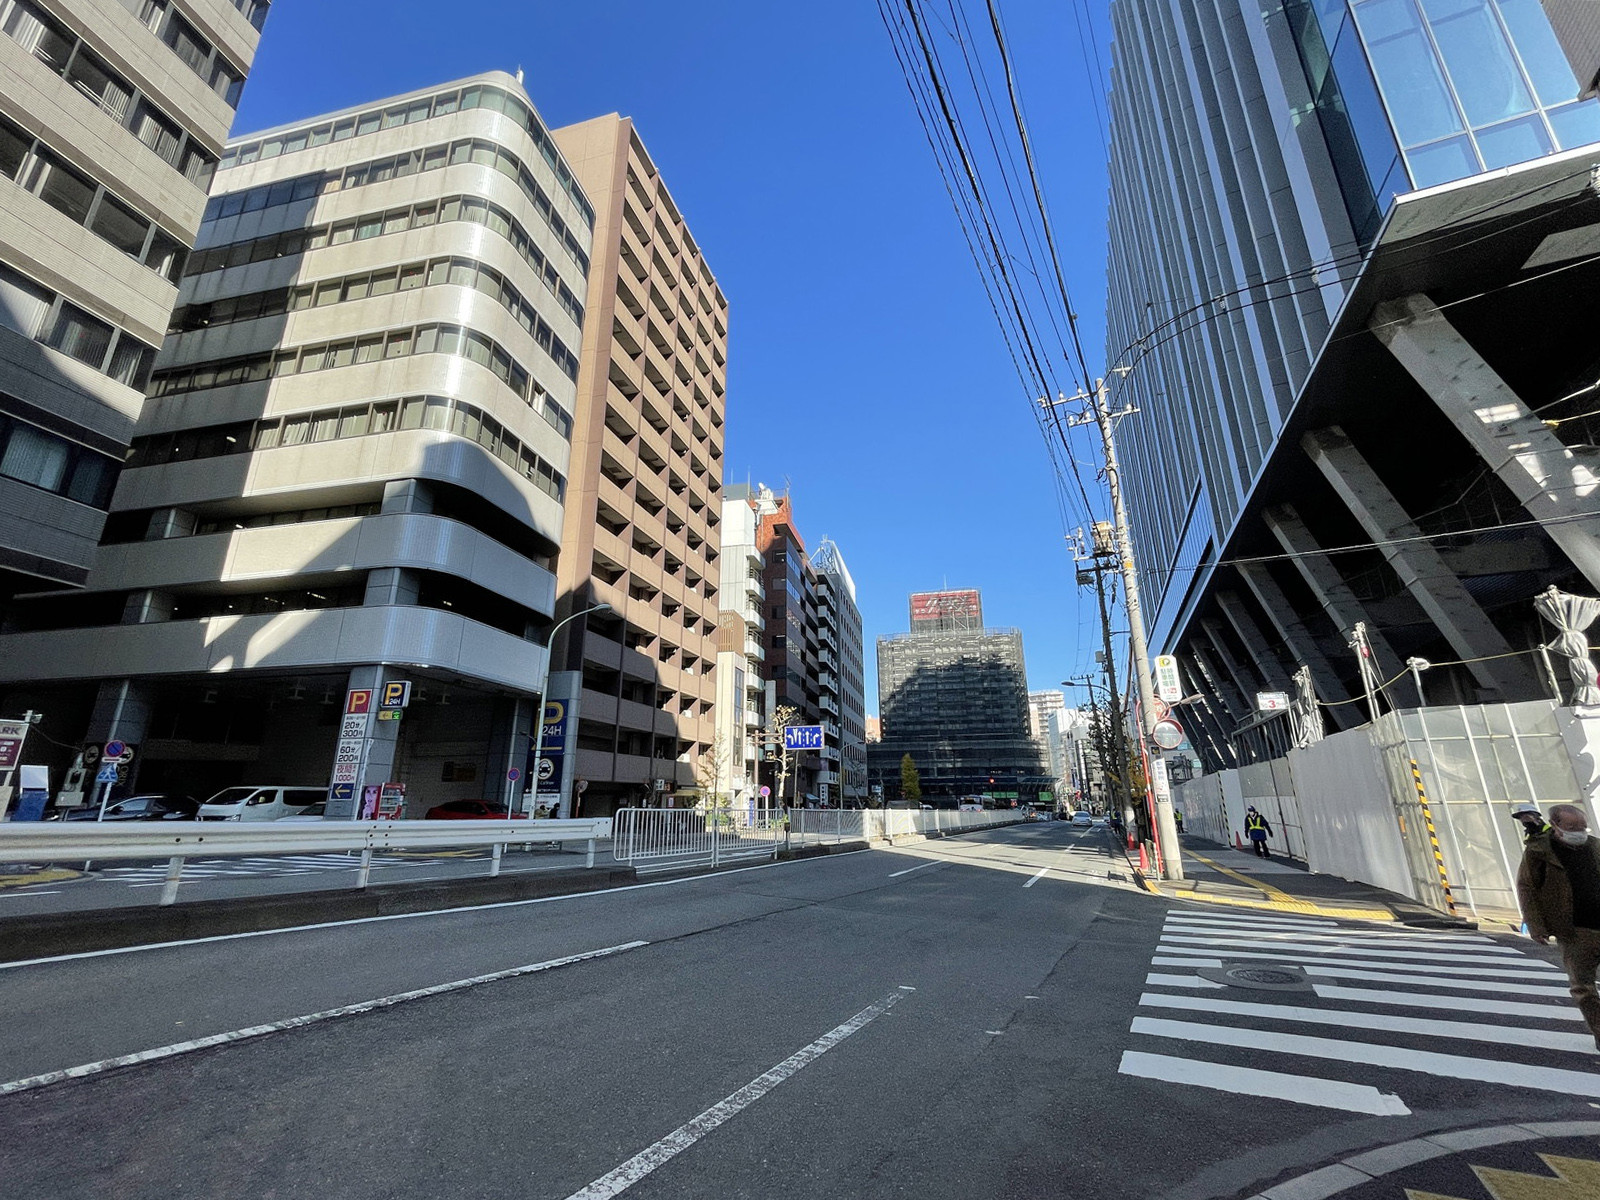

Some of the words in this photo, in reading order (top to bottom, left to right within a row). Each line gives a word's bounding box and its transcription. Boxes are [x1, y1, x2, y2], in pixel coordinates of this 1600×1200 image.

[350, 692, 367, 712] P
[384, 683, 403, 705] P
[542, 725, 562, 736] 24H
